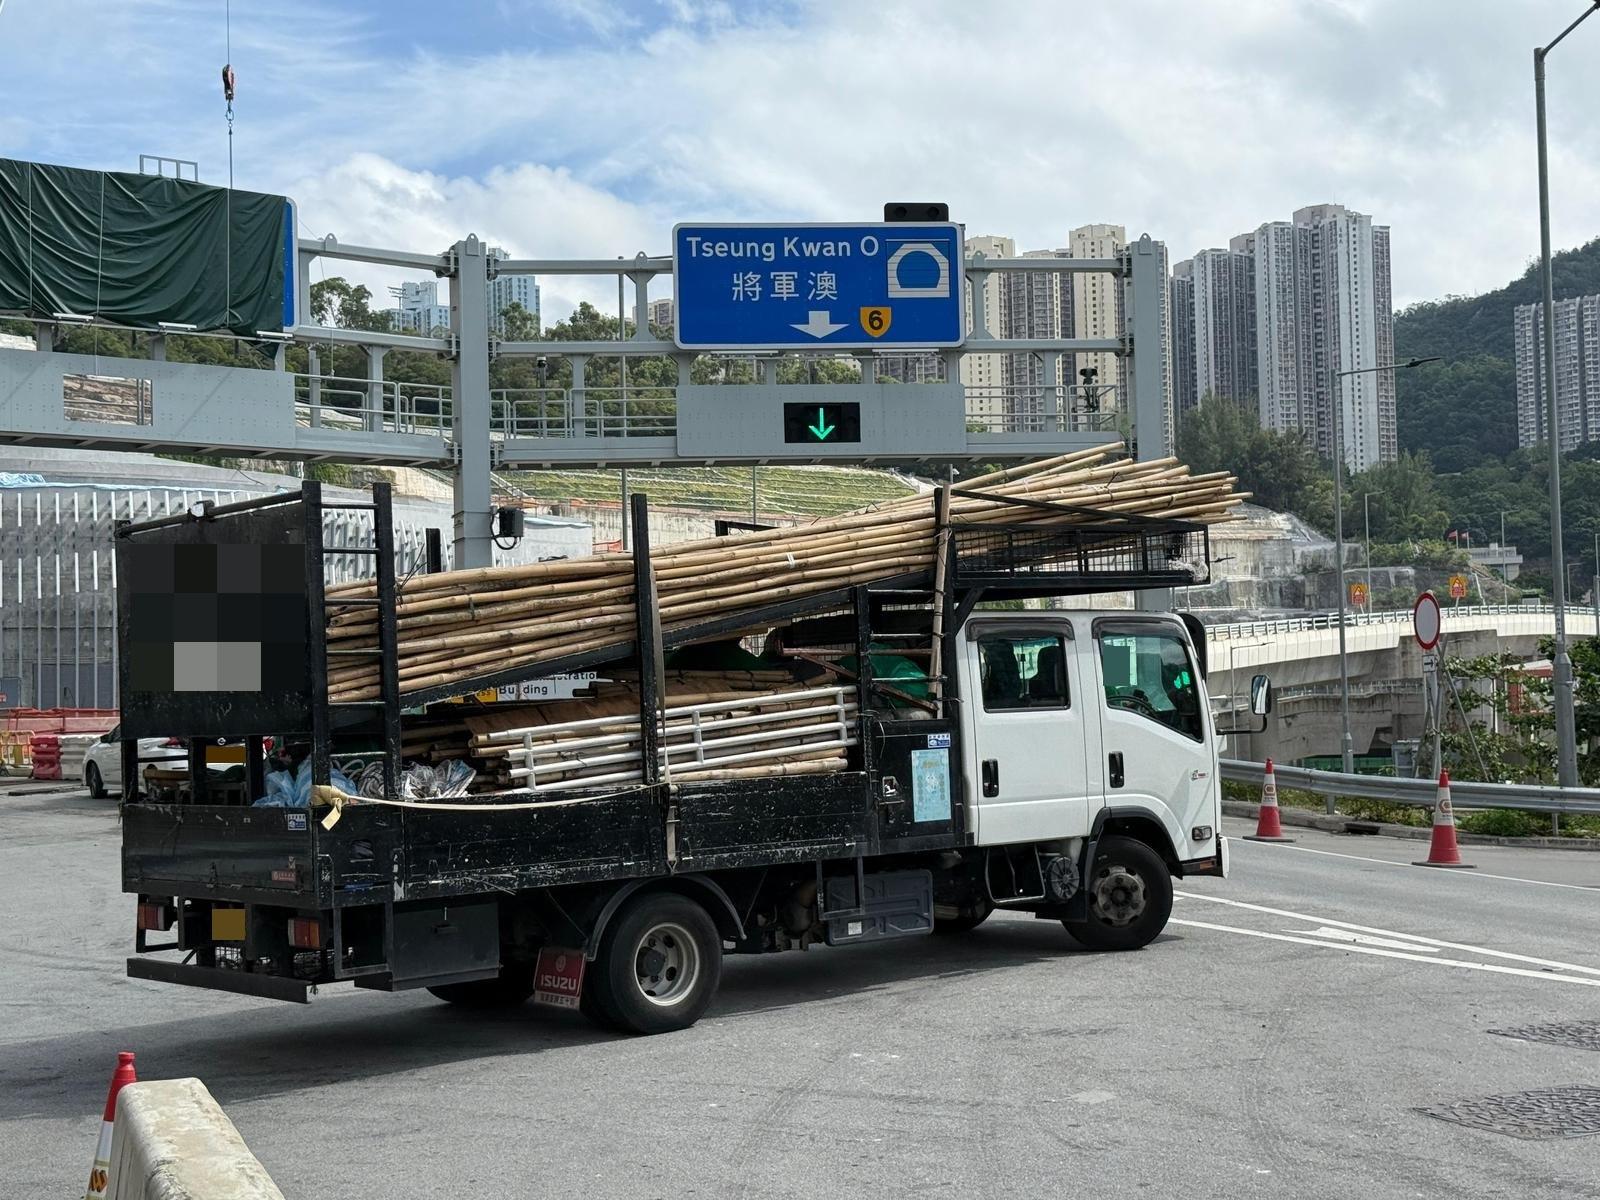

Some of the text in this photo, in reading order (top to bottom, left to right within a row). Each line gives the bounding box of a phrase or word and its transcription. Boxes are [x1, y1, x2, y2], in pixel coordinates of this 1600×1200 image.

[686, 235, 879, 261] Tseung Kwan O
[732, 271, 838, 301] 將軍澳
[868, 310, 884, 330] 6
[500, 686, 548, 695] Buding
[540, 974, 576, 990] ISUZU
